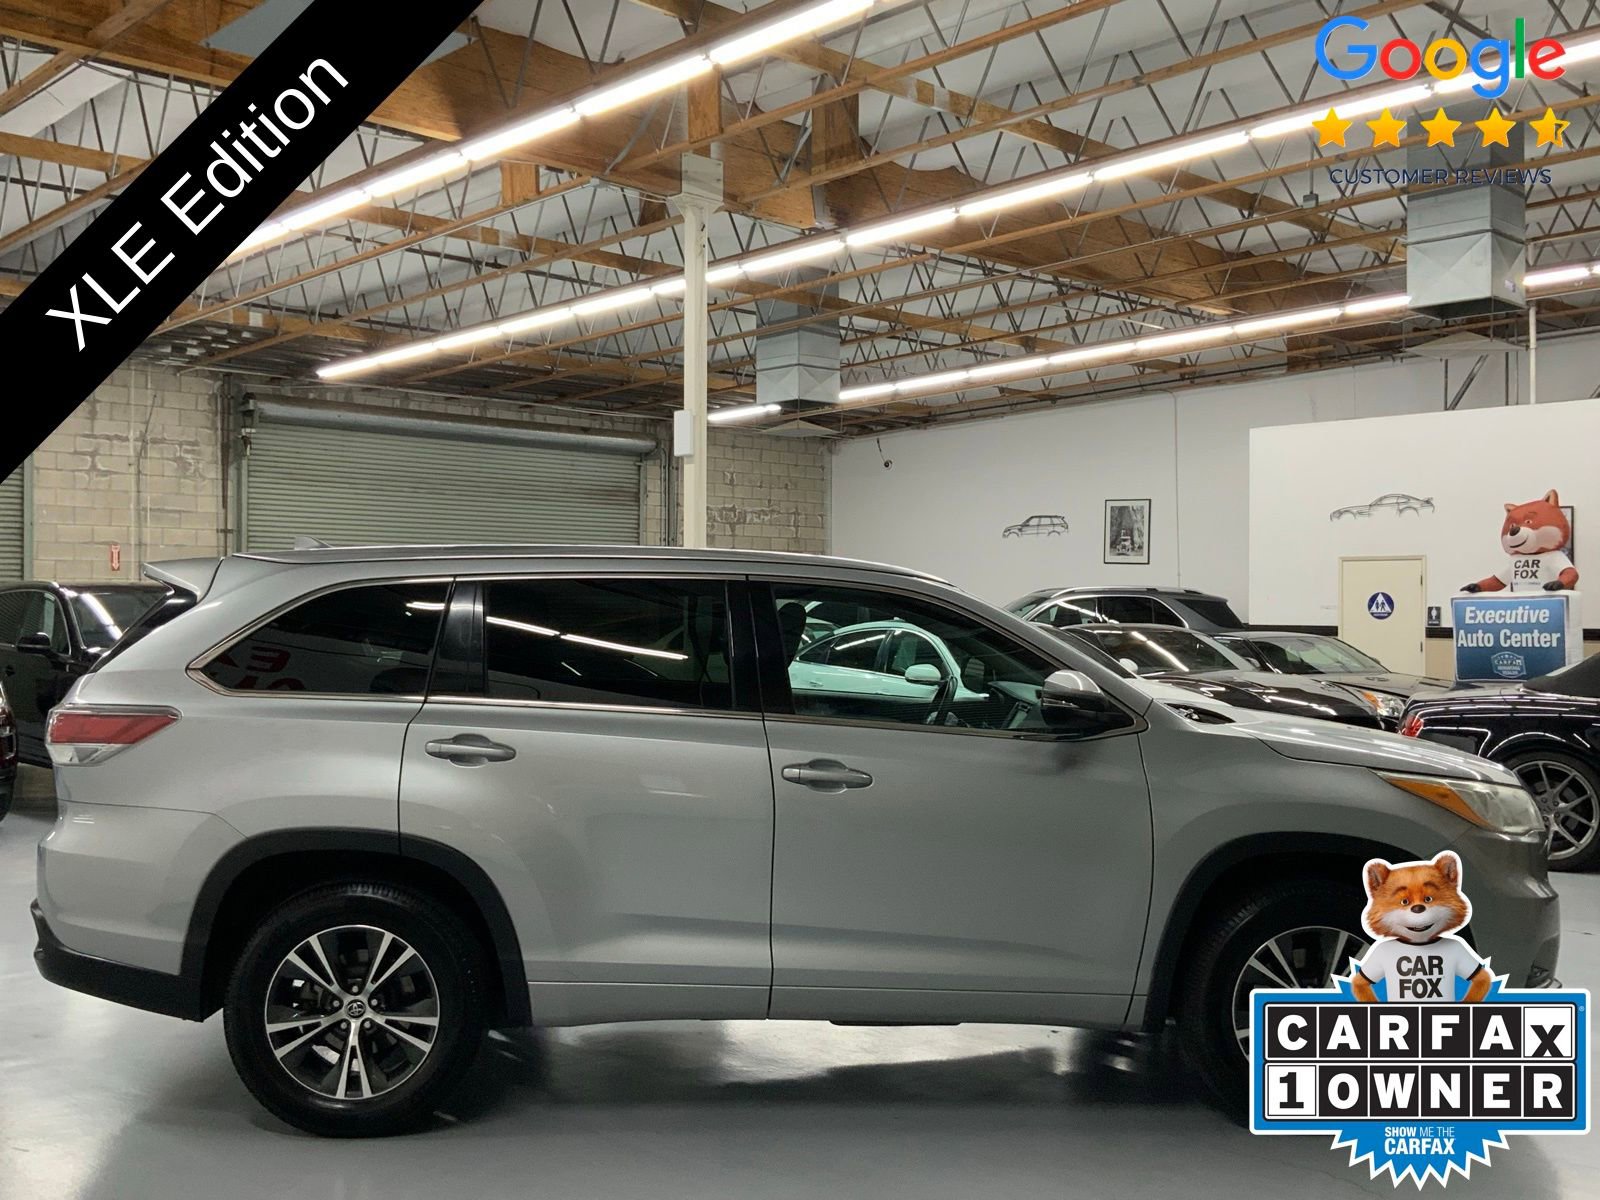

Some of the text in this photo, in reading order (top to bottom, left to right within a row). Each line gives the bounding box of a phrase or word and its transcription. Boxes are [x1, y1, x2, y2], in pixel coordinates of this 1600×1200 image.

[1514, 559, 1541, 569] CAR
[1514, 569, 1539, 580] FOX
[1464, 606, 1550, 624] Executive
[1457, 629, 1561, 648] Auto Center
